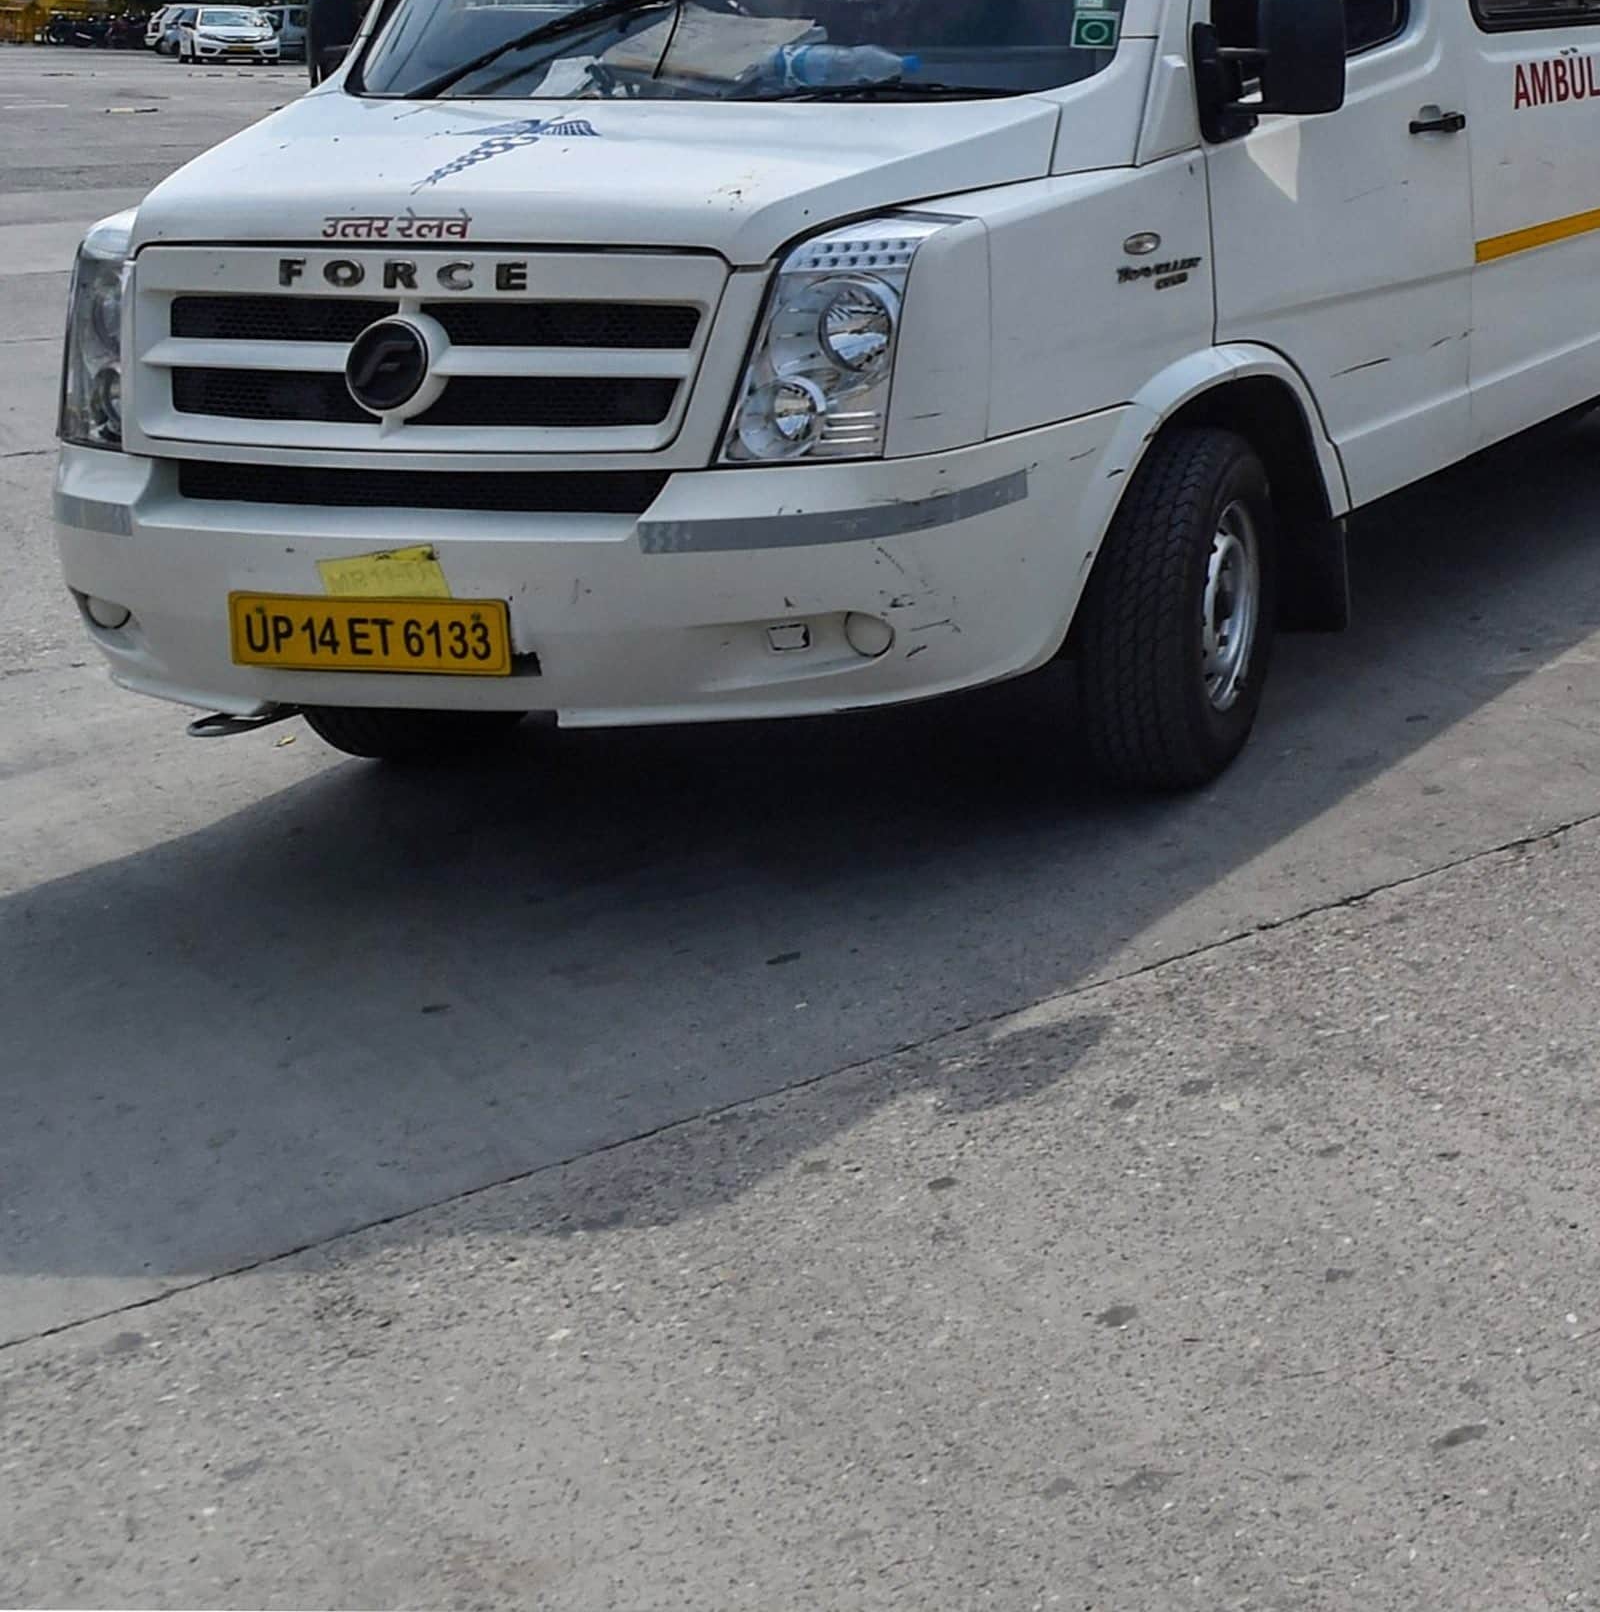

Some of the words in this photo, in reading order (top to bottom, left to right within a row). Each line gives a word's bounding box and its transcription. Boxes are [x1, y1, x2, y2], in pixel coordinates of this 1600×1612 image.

[321, 216, 394, 238] उत्तर
[397, 206, 473, 239] रेलवे
[279, 257, 527, 291] FORCE
